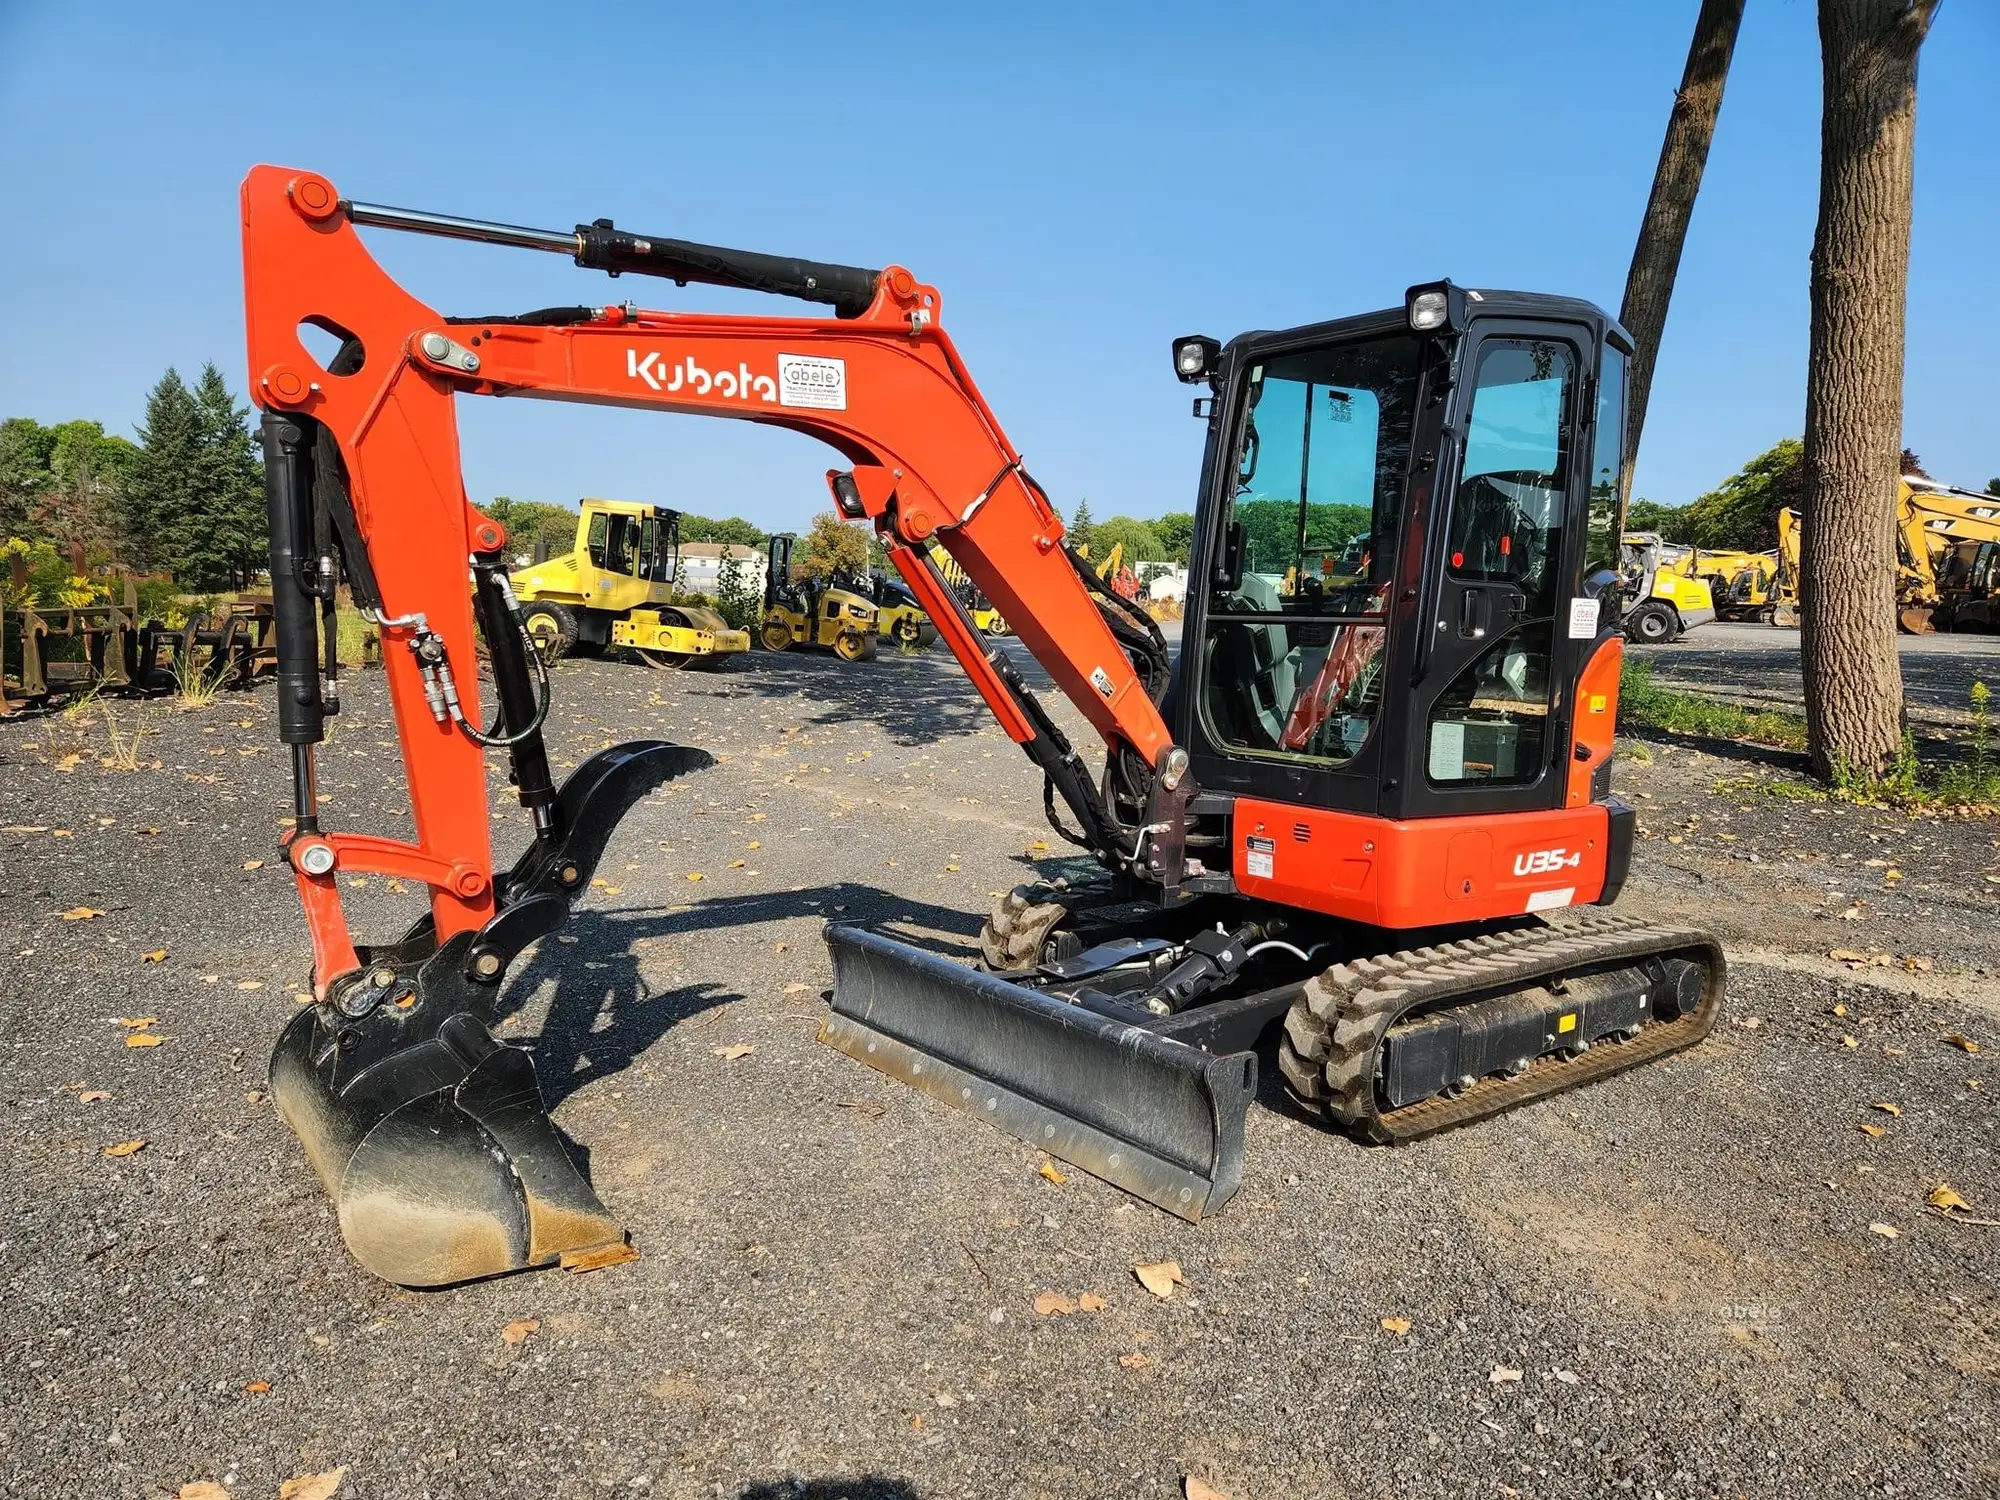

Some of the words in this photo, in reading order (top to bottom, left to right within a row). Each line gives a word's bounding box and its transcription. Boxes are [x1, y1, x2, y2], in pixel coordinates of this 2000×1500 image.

[626, 349, 777, 402] Kubota
[790, 367, 834, 383] abele
[1976, 507, 1992, 518] CAT
[1933, 520, 1948, 529] CAT
[1650, 547, 1678, 556] VLVO
[1513, 848, 1581, 876] U35-4
